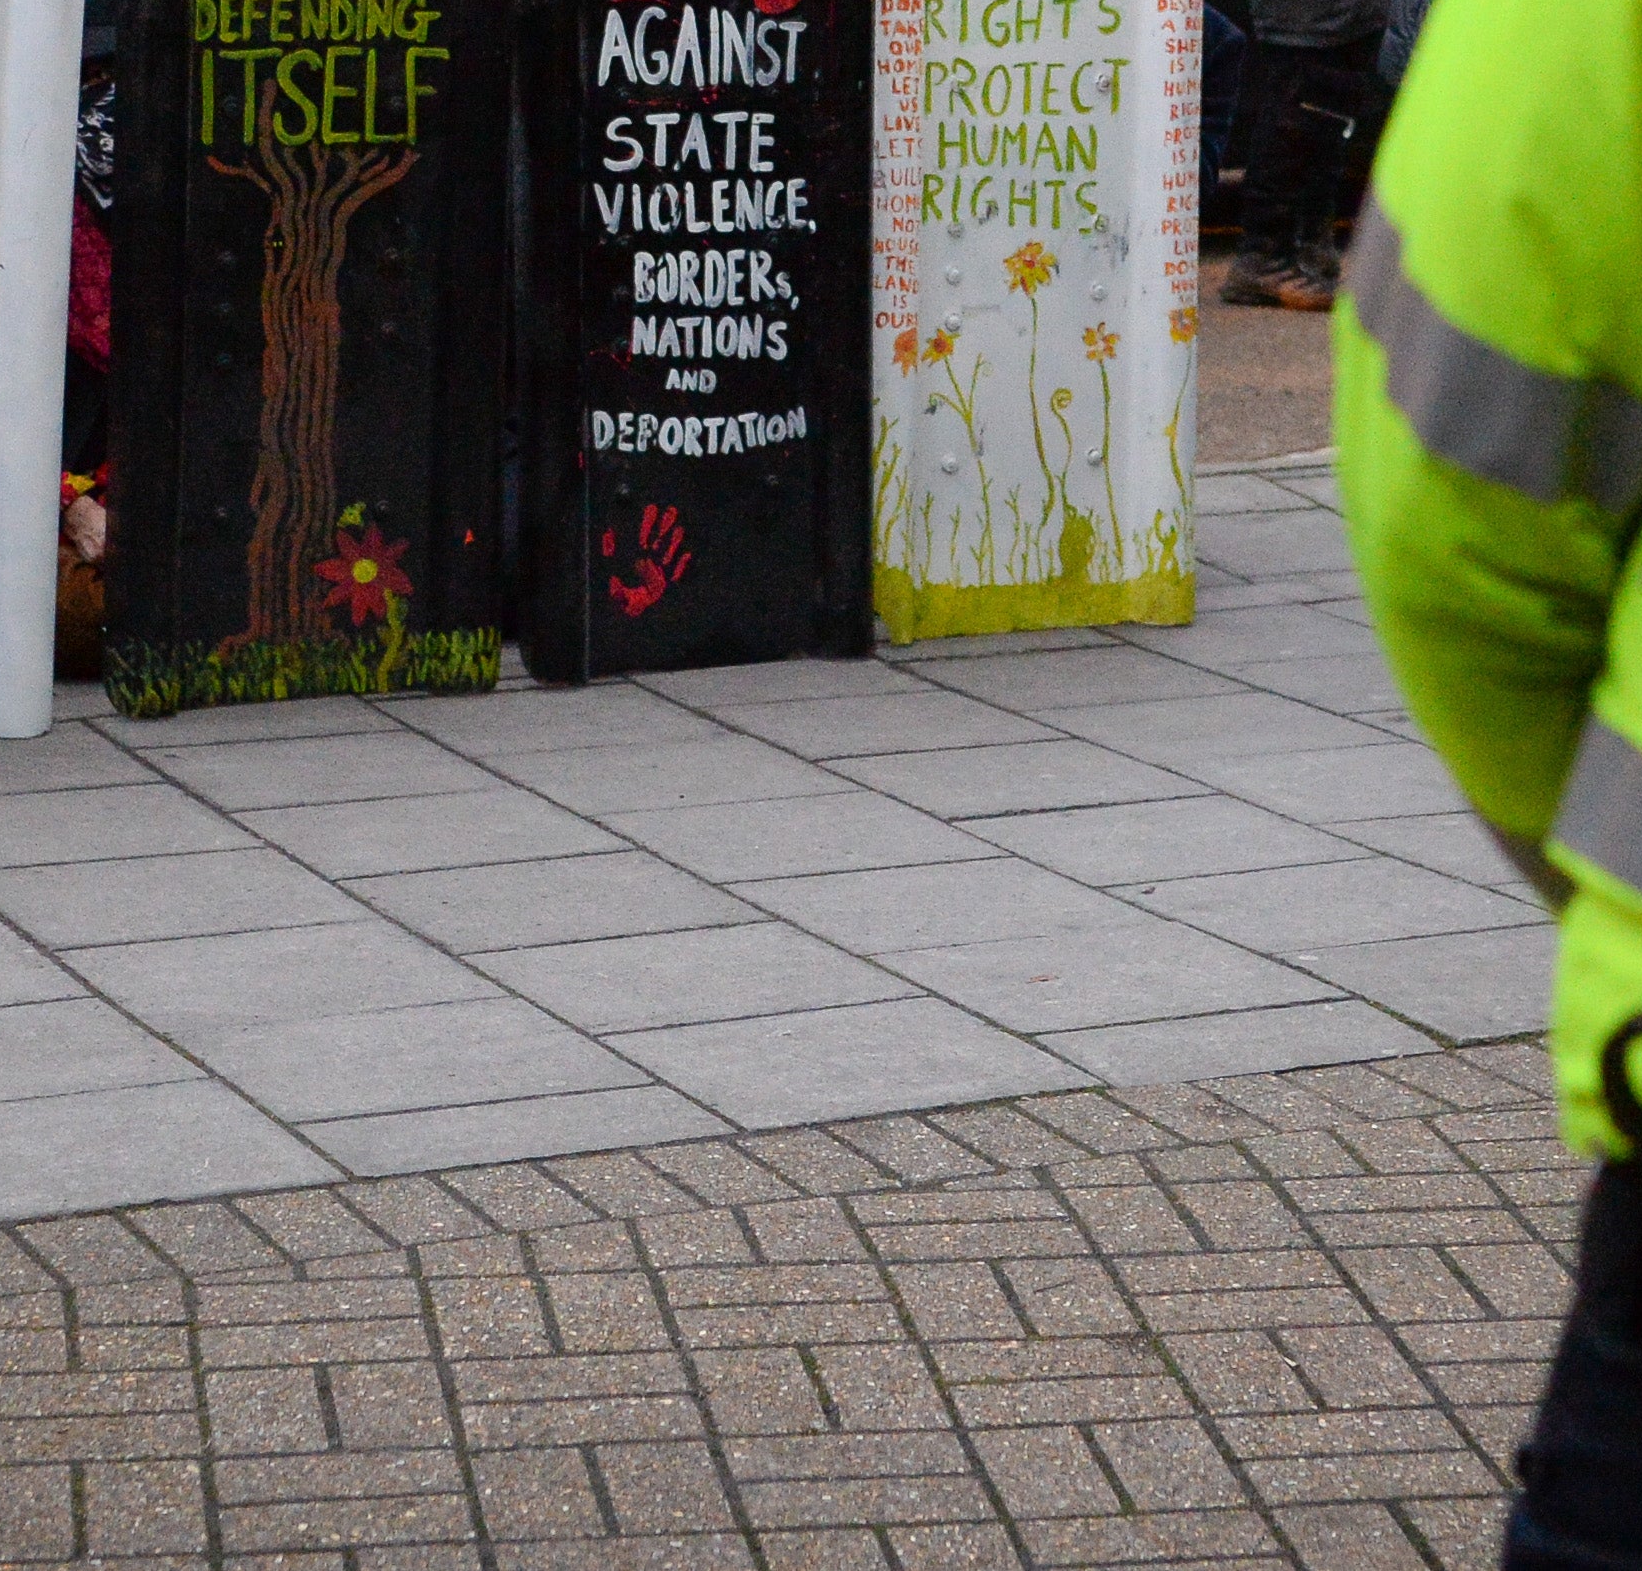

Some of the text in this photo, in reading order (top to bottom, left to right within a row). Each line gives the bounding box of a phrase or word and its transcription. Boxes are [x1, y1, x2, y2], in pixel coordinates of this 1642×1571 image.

[598, 4, 807, 86] AGAINST
[201, 47, 450, 146] ITSELF
[924, 58, 1130, 117] PROTECT
[602, 111, 775, 172] STATE
[938, 120, 1097, 172] HUMAN
[921, 173, 1099, 236] RIGHTS
[632, 314, 788, 360] NATIONS
[666, 369, 717, 393] AND
[592, 407, 807, 457] DEPORTATION
